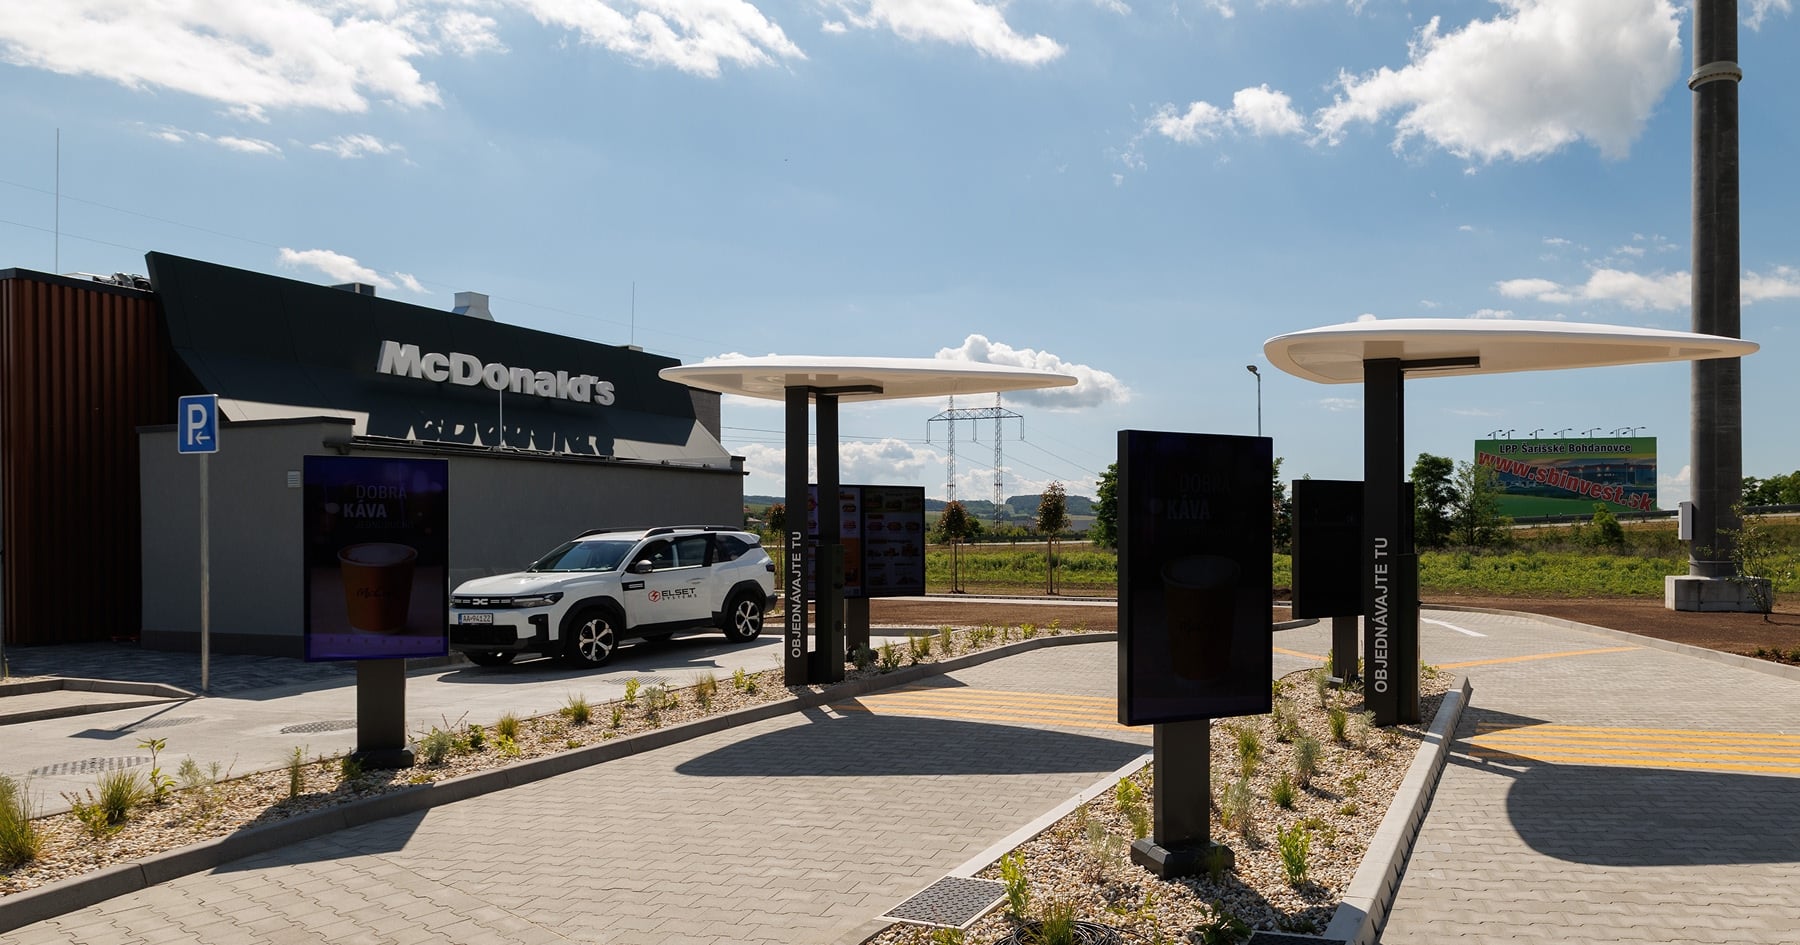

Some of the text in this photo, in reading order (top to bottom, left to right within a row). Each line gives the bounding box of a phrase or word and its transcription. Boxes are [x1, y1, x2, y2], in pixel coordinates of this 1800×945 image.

[376, 340, 615, 406] McDonald's
[187, 403, 208, 445] P
[1499, 442, 1632, 454] LPP Šarišské Bohdanovce
[1478, 452, 1655, 511] www.sbinvest.sk
[343, 499, 387, 518] KÁVA
[661, 587, 696, 597] ELSET
[790, 531, 802, 658] OBJEDNÁVAJTE TU
[1371, 537, 1389, 694] OBJEDNÁVAJTE TU
